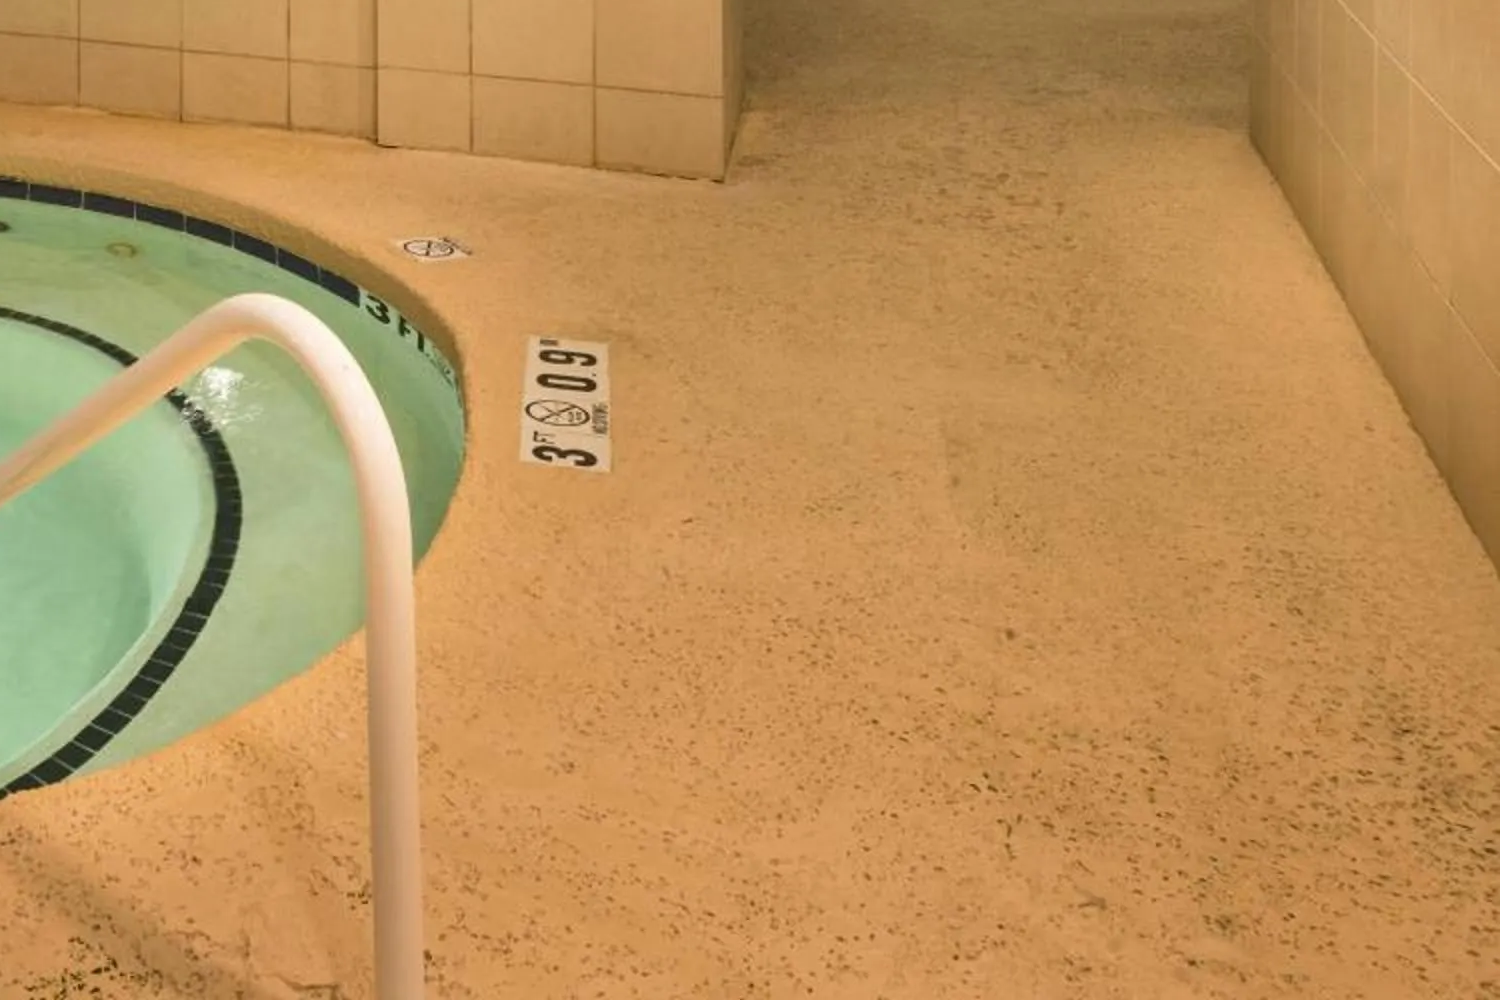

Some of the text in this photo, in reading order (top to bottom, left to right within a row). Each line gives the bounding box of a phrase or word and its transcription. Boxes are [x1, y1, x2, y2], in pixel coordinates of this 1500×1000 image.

[366, 294, 390, 324] 3
[536, 350, 597, 392] 0.9
[532, 431, 597, 467] 3 FT
